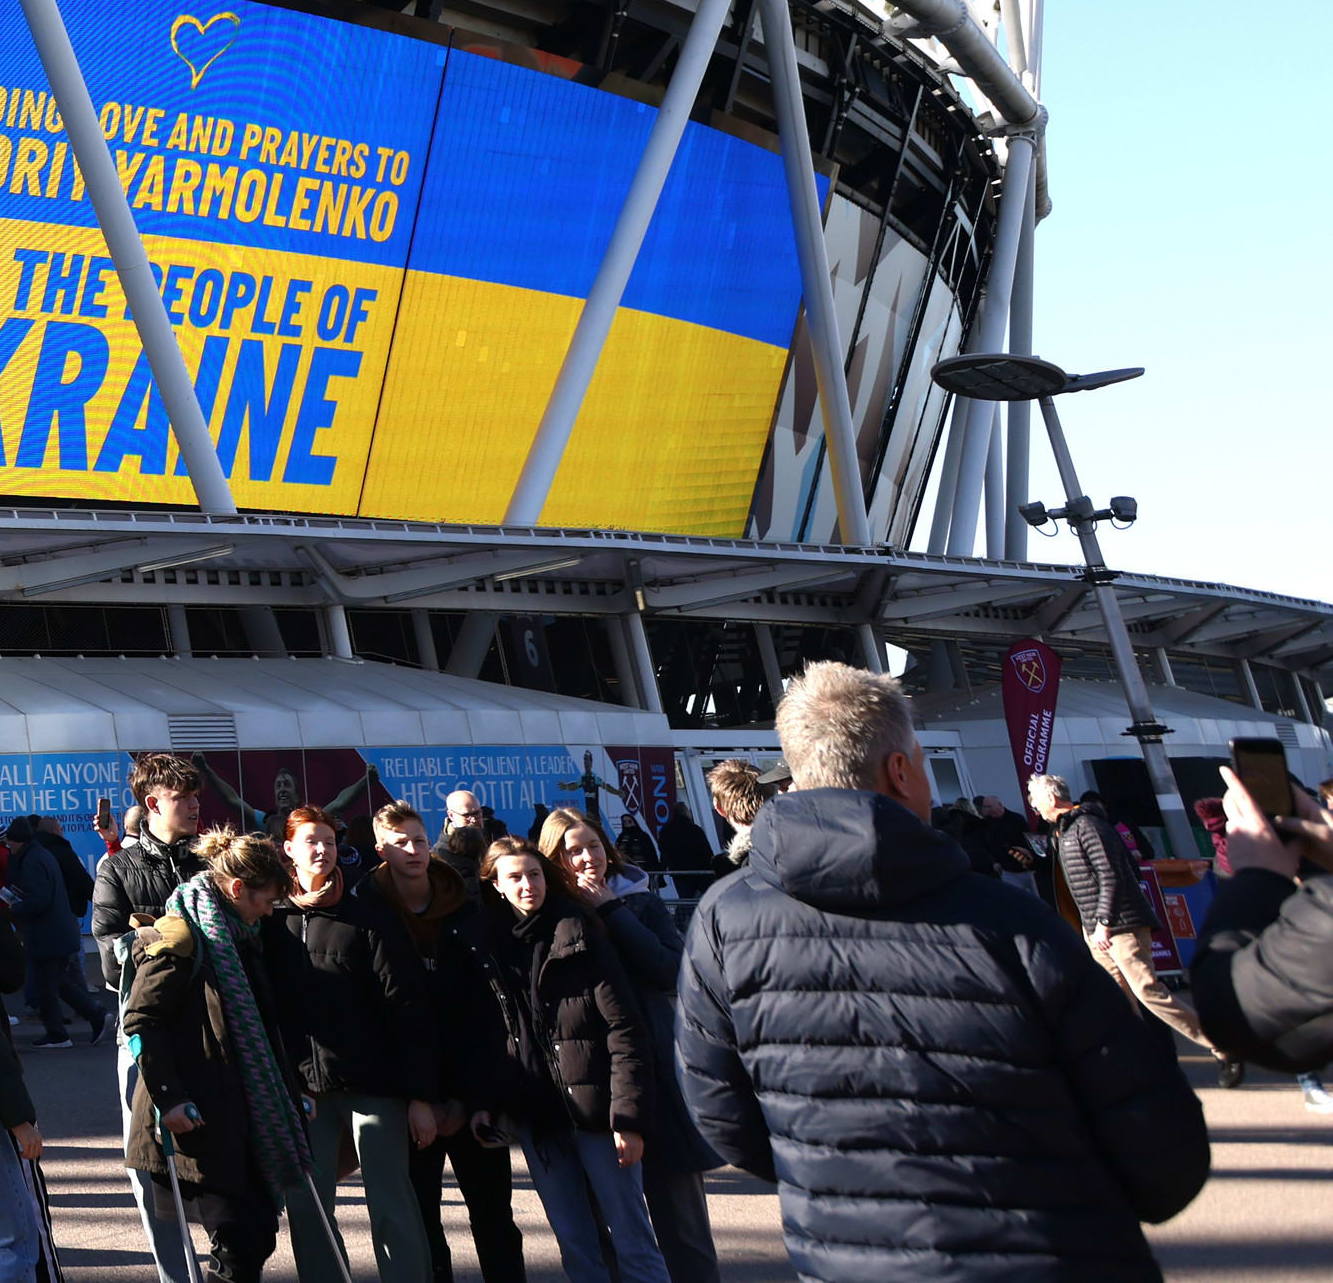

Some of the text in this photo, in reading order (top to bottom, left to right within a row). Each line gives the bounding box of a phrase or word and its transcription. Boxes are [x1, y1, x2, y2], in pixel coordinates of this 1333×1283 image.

[99, 101, 165, 147] OVE
[166, 113, 234, 157] AND
[240, 123, 369, 178] PRAYERS
[376, 146, 411, 187] TO
[115, 149, 399, 243] YARMOLENKO
[13, 248, 117, 319] THE
[316, 284, 378, 344] OF
[534, 756, 576, 775] LEADER
[1023, 713, 1040, 766] OFFICIAL
[1034, 708, 1052, 778] OGRAMME
[34, 790, 58, 813] HE
[63, 789, 80, 811] IS
[82, 788, 120, 810] THE
[43, 761, 120, 785] ANYONE
